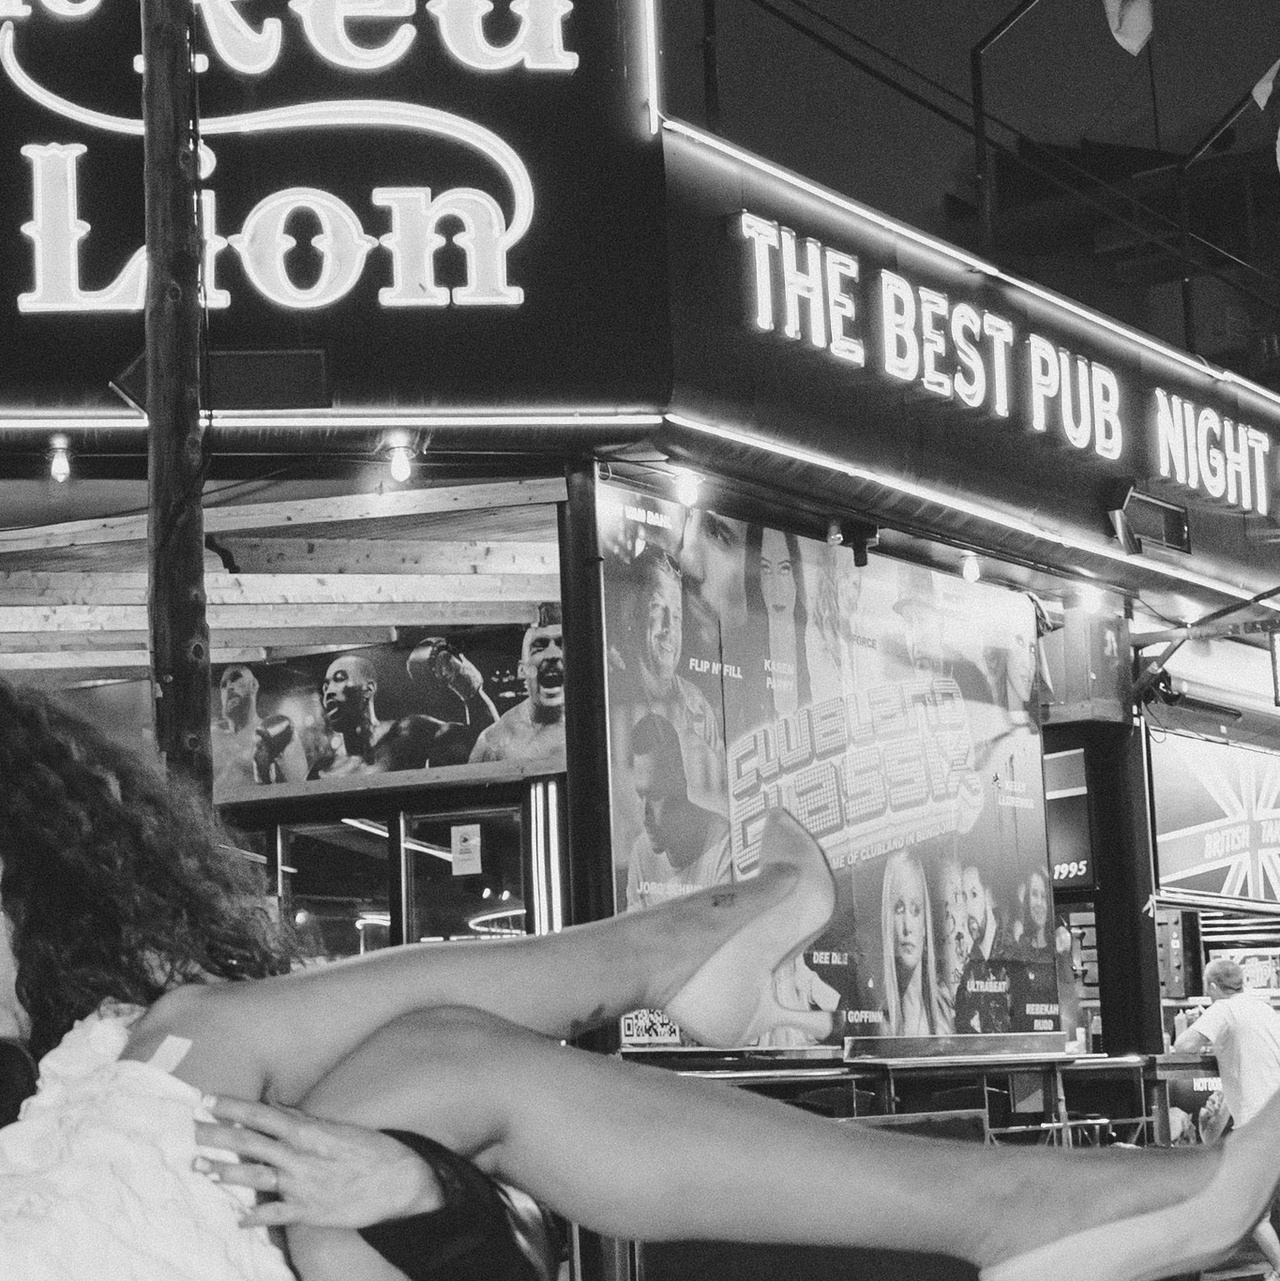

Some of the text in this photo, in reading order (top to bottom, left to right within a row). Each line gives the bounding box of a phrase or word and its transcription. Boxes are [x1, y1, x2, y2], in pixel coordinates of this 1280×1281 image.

[17, 142, 526, 312] Lion
[741, 208, 1269, 516] THE BEST PUB NIGHT
[689, 658, 710, 673] FLIP
[722, 664, 743, 679] FILL
[1053, 860, 1088, 880] 1995
